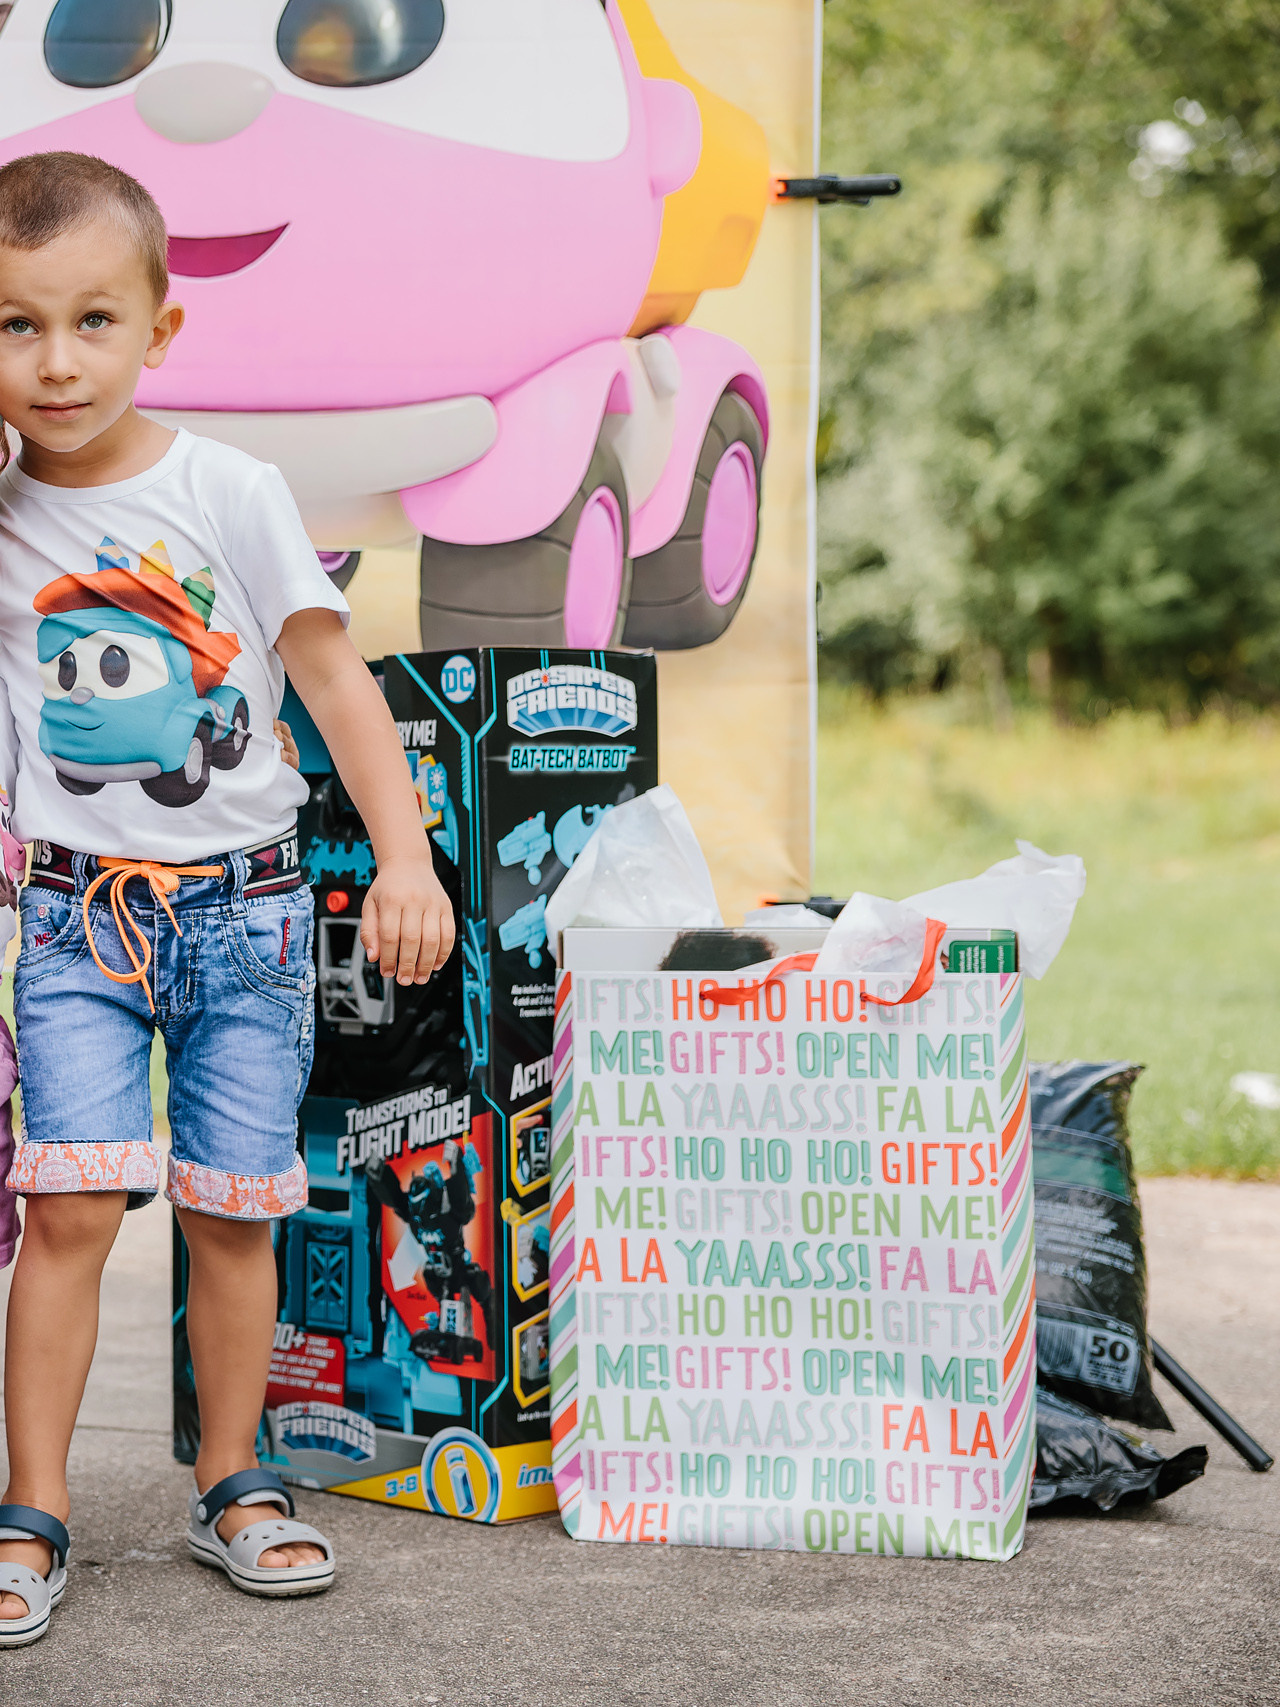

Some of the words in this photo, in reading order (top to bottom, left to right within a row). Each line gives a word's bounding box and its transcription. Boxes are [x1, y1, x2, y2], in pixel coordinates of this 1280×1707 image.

[441, 667, 473, 693] DC
[507, 669, 541, 700] DC
[549, 665, 636, 702] SUPER
[507, 684, 638, 726] FRIENDS
[395, 721, 412, 747] RY
[412, 719, 437, 747] ME!
[510, 746, 575, 771] BAT-TECH
[576, 746, 629, 771] BATBOT
[577, 978, 664, 1023] IFTS!
[672, 979, 719, 1021] HO
[738, 979, 786, 1022] HO
[805, 979, 867, 1023] HO!
[590, 1030, 665, 1075] ME!
[670, 1031, 786, 1075] GIFTS!
[797, 1032, 899, 1079] OPEN
[917, 1033, 996, 1081] ME!
[345, 1085, 434, 1135] TRANSFORMS
[574, 1081, 600, 1126] A
[618, 1081, 665, 1127] LA
[671, 1083, 867, 1134] YAAASSS!
[877, 1086, 926, 1133] FA
[945, 1086, 995, 1133] LA
[336, 1119, 405, 1172] FLIGHT
[407, 1094, 471, 1149] MODE!
[582, 1136, 668, 1178] IFTS!
[675, 1136, 725, 1181] HO
[741, 1137, 791, 1183] HO
[807, 1140, 872, 1186] HO!
[881, 1142, 999, 1186] GIFTS!
[595, 1186, 667, 1230] ME!
[676, 1188, 793, 1236] GIFTS!
[801, 1191, 901, 1237] OPEN
[921, 1195, 997, 1240] ME!
[576, 1237, 602, 1282] A
[621, 1237, 668, 1283] LA
[674, 1239, 871, 1292] YAAASSS!
[880, 1246, 929, 1292] FA
[948, 1248, 998, 1295] LA
[582, 1292, 670, 1336] IFTS!
[678, 1294, 725, 1336] HO
[744, 1295, 792, 1338] HO
[811, 1297, 873, 1340] HO!
[882, 1301, 1000, 1350] GIFTS!
[1090, 1335, 1129, 1362] 50
[596, 1344, 670, 1390] ME!
[676, 1346, 792, 1392] GIFTS!
[803, 1350, 905, 1397] OPEN
[922, 1355, 998, 1406] ME!
[276, 1418, 376, 1459] FRIENDS
[579, 1395, 605, 1440] A
[623, 1396, 671, 1442] LA
[678, 1398, 872, 1450] YAAASSS!
[883, 1404, 930, 1453] FA
[950, 1409, 998, 1459] LA
[385, 1475, 418, 1498] 3-8
[588, 1450, 673, 1494] IFTS!
[681, 1453, 730, 1498] HO
[747, 1455, 796, 1500] HO
[812, 1457, 876, 1505] HO!
[886, 1461, 1001, 1513] GIFTS!
[598, 1501, 669, 1543] ME!
[677, 1504, 795, 1551] GIFTS!
[804, 1509, 904, 1555] OPEN
